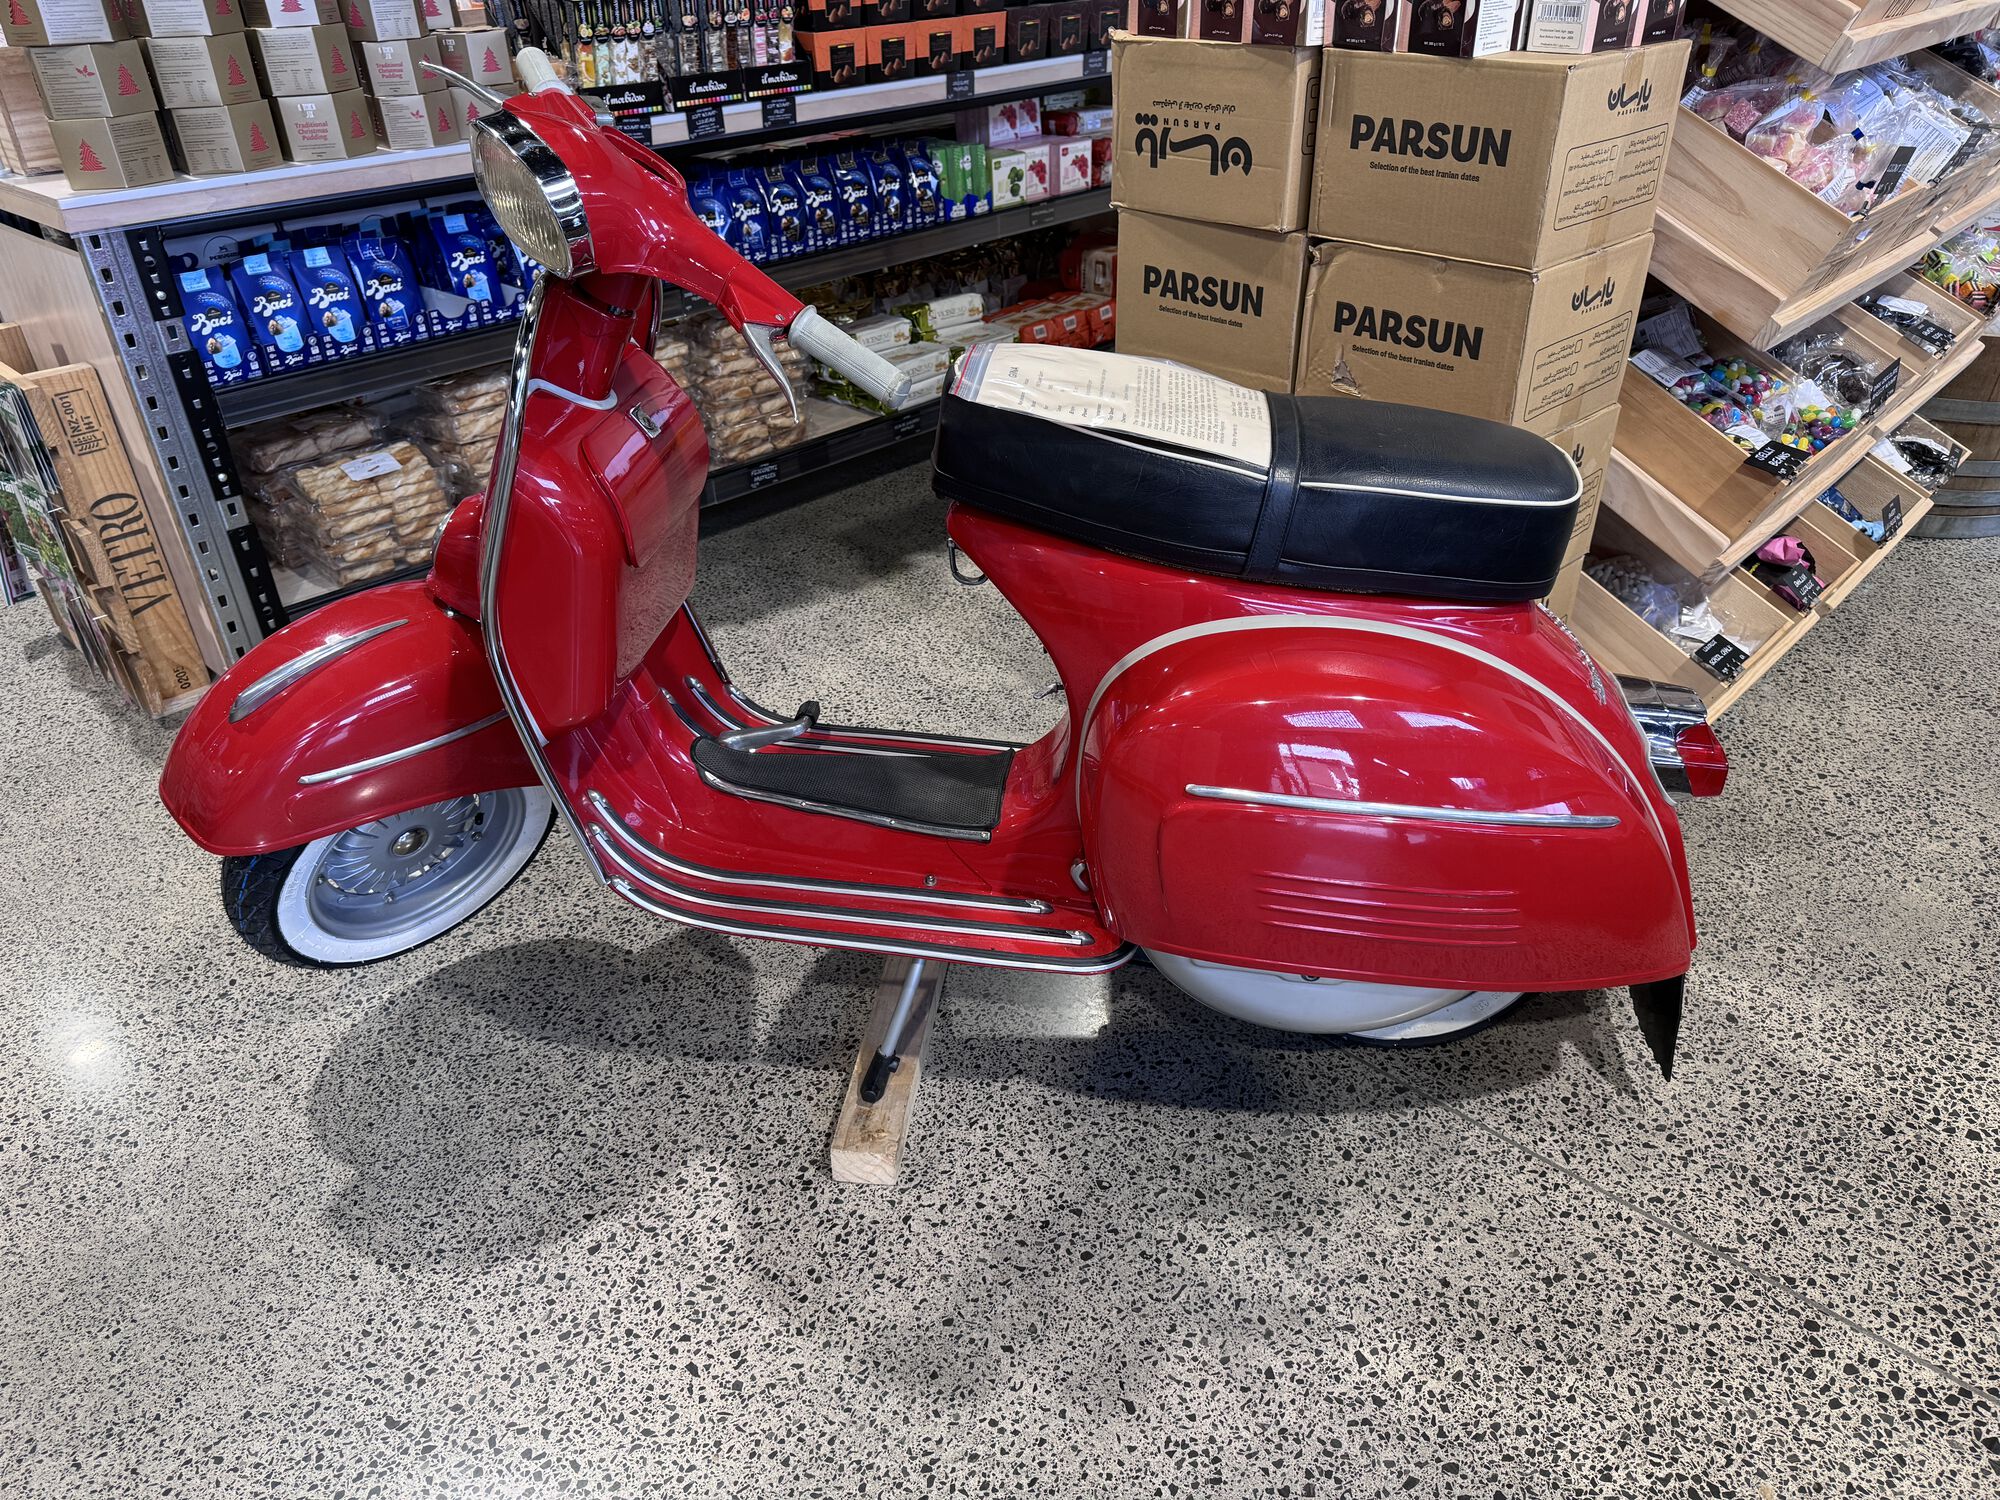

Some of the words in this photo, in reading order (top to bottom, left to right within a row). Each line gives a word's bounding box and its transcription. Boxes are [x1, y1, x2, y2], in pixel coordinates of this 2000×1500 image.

[378, 67, 404, 75] Christmas
[382, 72, 404, 80] Pudding
[294, 120, 328, 129] Traditional
[297, 127, 328, 135] Christmas
[1163, 117, 1221, 131] PARSUN
[302, 133, 328, 142] Pudding
[1135, 112, 1253, 176] پارسان
[1350, 114, 1512, 167] PARSUN
[909, 171, 932, 188] Baci
[1369, 161, 1399, 172] Selection
[1408, 167, 1419, 175] the
[1420, 168, 1435, 178] best
[1435, 169, 1459, 180] Iranian
[1460, 172, 1480, 182] dates
[843, 185, 868, 203] Baci
[878, 178, 900, 195] Baci
[772, 198, 798, 216] Baci
[806, 190, 832, 208] Baci
[735, 202, 761, 221] Baci
[451, 251, 487, 272] Baci
[308, 286, 351, 309] Baci
[366, 278, 403, 300] Baci
[1143, 264, 1264, 317] PARSUN
[253, 293, 294, 317] Baci
[191, 310, 234, 336] Baci
[1159, 304, 1181, 315] Selection
[1188, 311, 1197, 319] the
[1198, 312, 1209, 321] best
[1210, 315, 1228, 325] Iranian
[1228, 319, 1243, 328] dates
[1334, 300, 1484, 360] PARSUN
[340, 343, 358, 355] Baci
[1352, 344, 1379, 356] Selection
[1380, 350, 1387, 358] of
[1388, 351, 1398, 361] the
[1399, 353, 1413, 363] best
[1414, 357, 1436, 368] Iranian
[1436, 361, 1455, 372] dates
[284, 353, 304, 366] Baci
[223, 368, 243, 381] Baci
[59, 394, 82, 434] NZ-001
[80, 415, 95, 431] HT
[1754, 446, 1776, 461] JELLY
[1768, 451, 1791, 467] BEANS
[89, 492, 173, 619] VETRO
